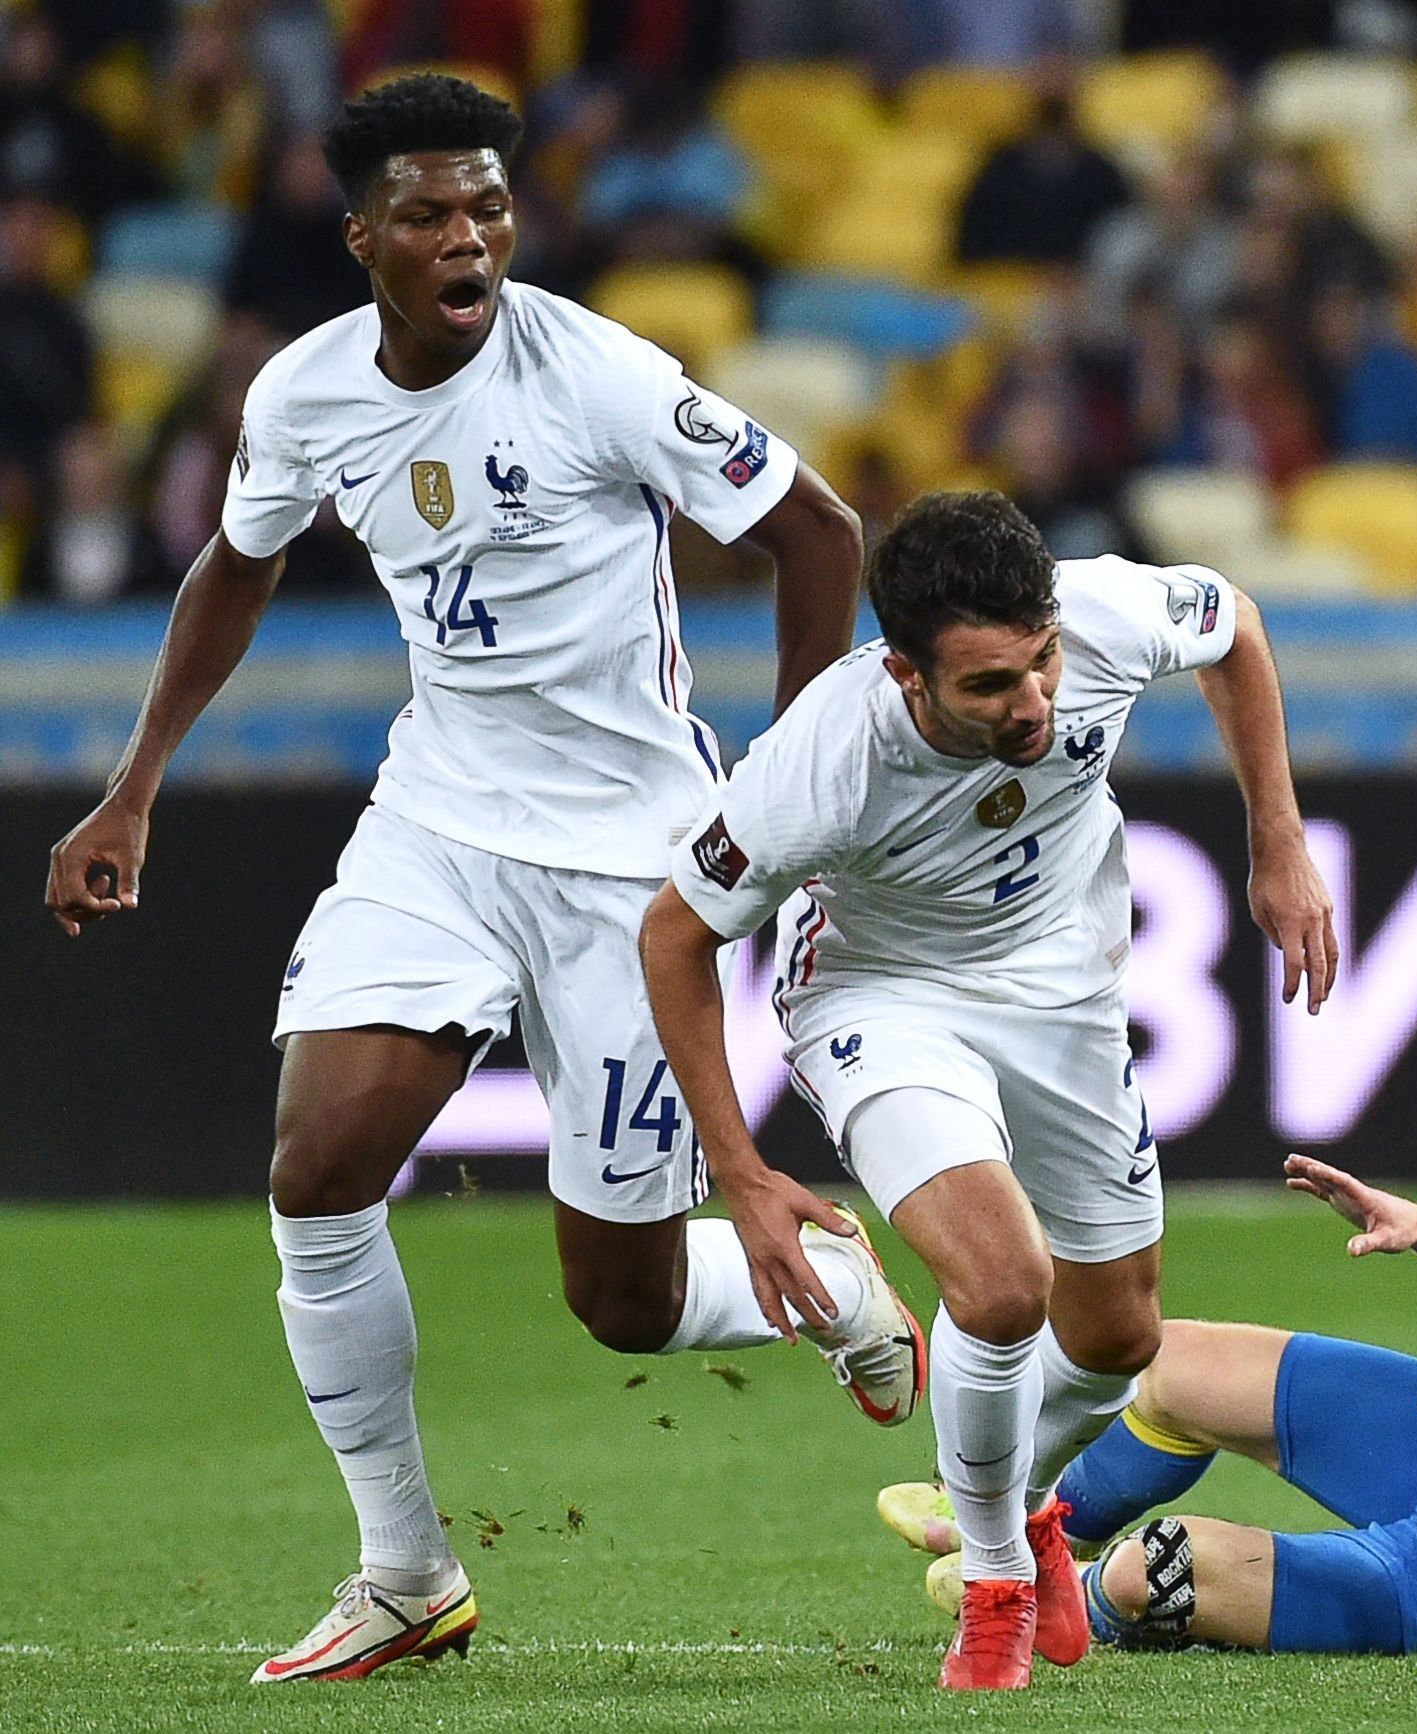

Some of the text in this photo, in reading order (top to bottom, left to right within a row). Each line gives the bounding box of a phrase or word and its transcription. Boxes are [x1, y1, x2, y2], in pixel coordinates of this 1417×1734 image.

[419, 564, 499, 647] 14
[993, 833, 1040, 904] 2
[599, 1057, 681, 1153] 14
